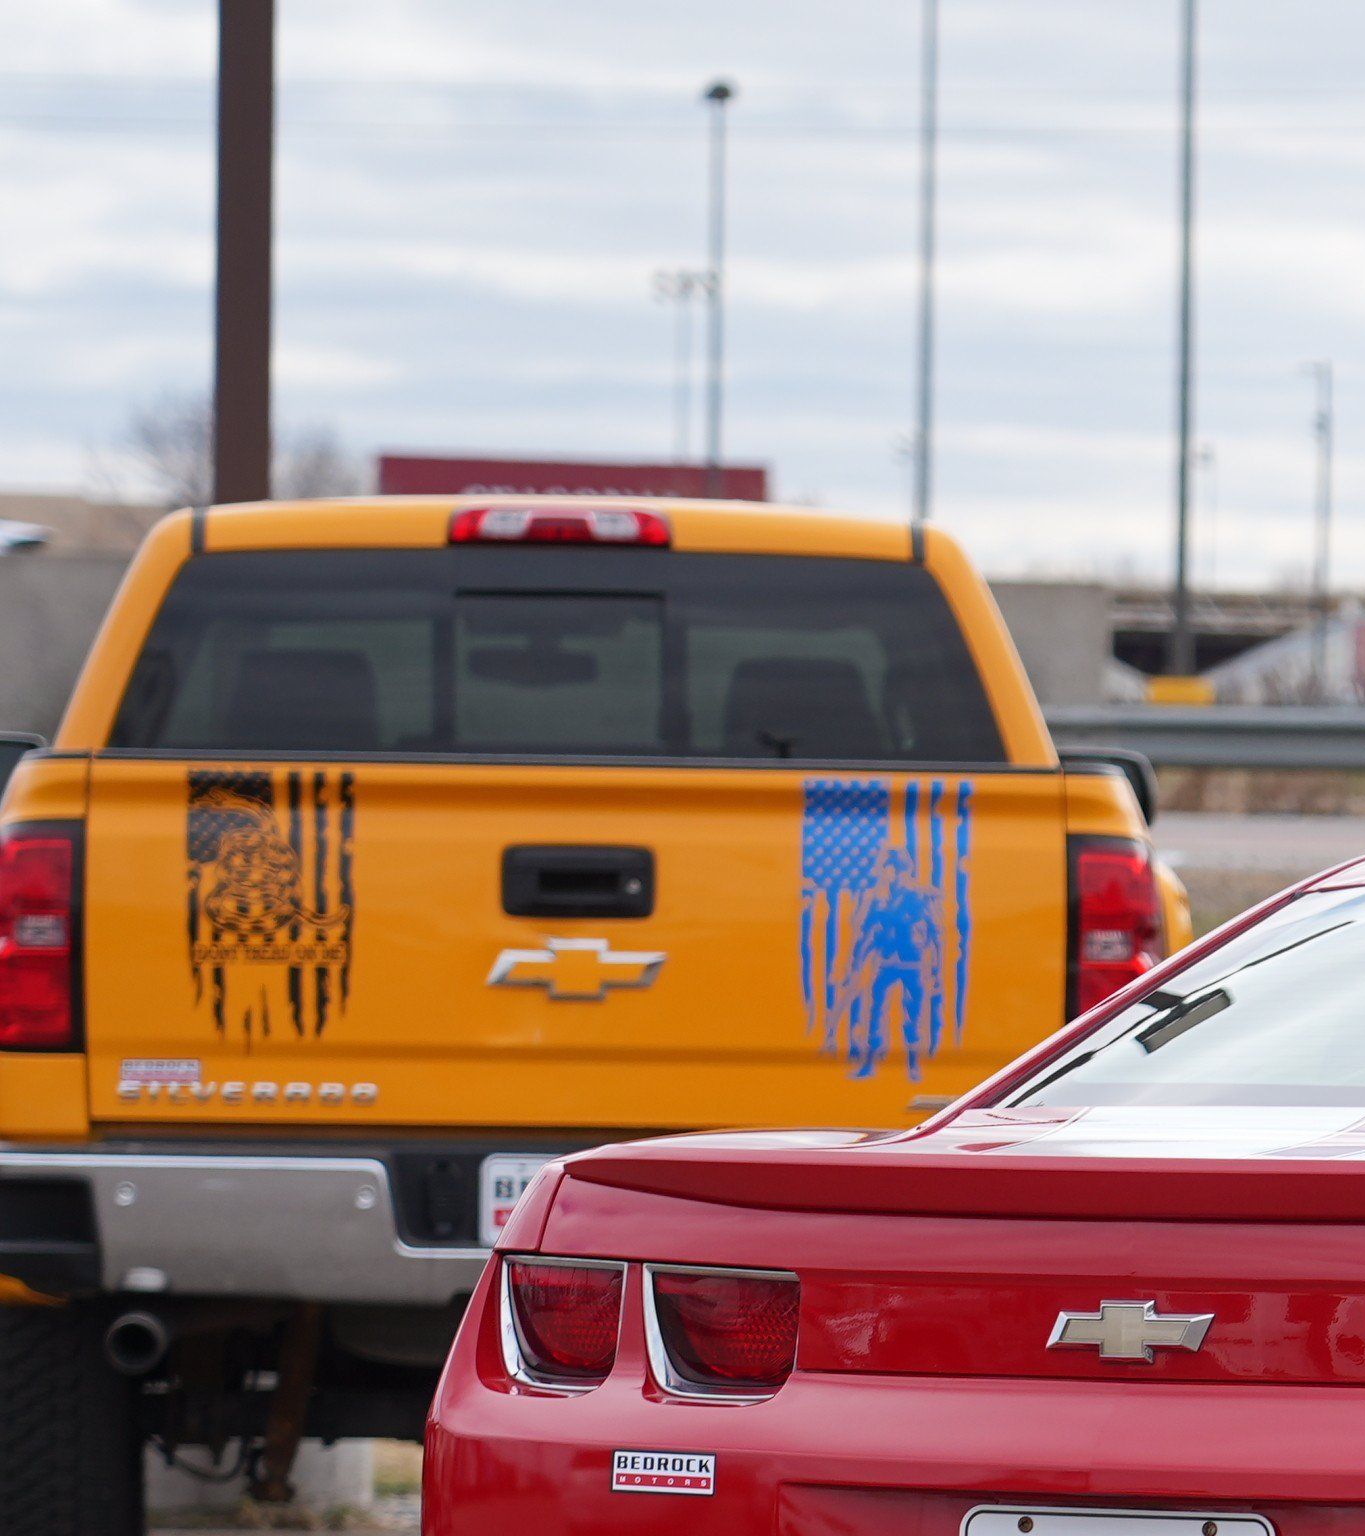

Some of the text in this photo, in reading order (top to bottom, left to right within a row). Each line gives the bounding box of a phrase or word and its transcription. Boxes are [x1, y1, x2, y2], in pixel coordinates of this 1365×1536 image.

[118, 1081, 379, 1106] SILVERADO
[616, 1455, 710, 1473] BEDROCK
[619, 1476, 708, 1488] MOTORS
